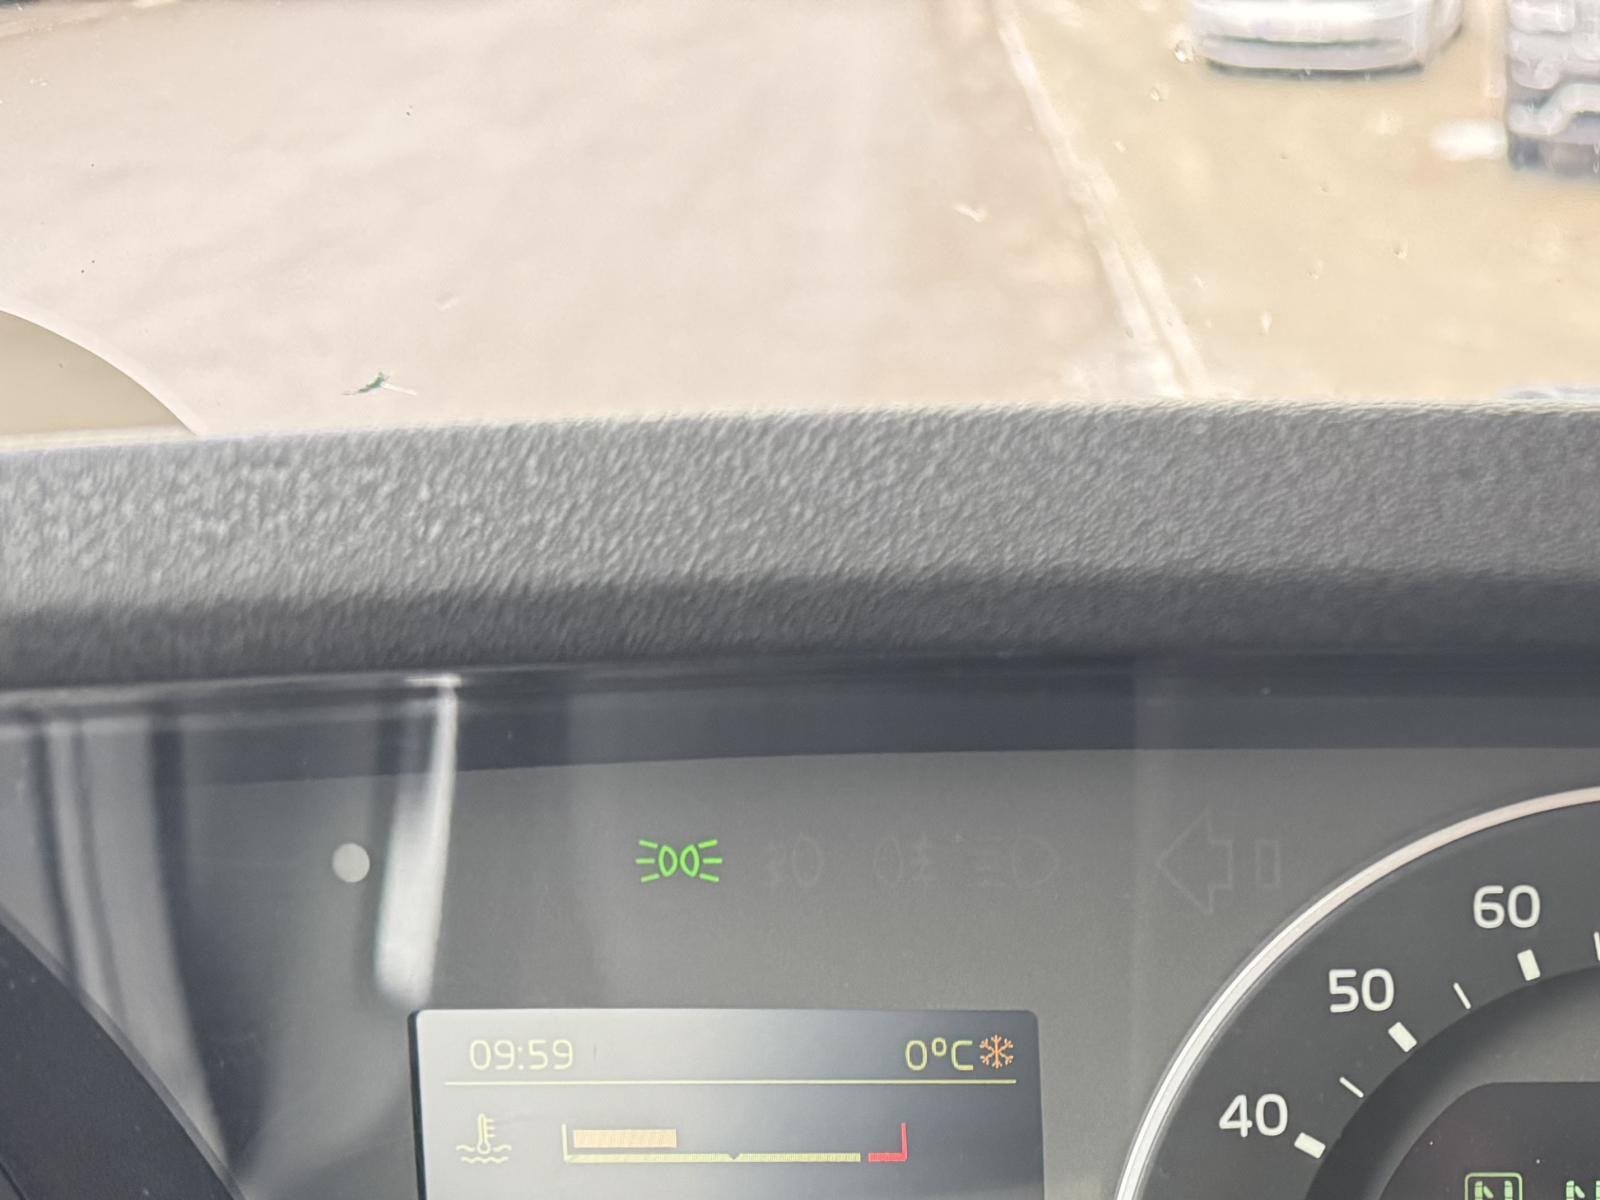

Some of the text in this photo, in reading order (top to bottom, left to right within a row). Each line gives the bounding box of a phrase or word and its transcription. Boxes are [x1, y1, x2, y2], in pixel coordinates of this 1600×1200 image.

[1472, 884, 1542, 929] 60
[1327, 968, 1396, 1014] 50
[469, 1037, 575, 1072] 09:59
[1218, 1093, 1289, 1138] 40
